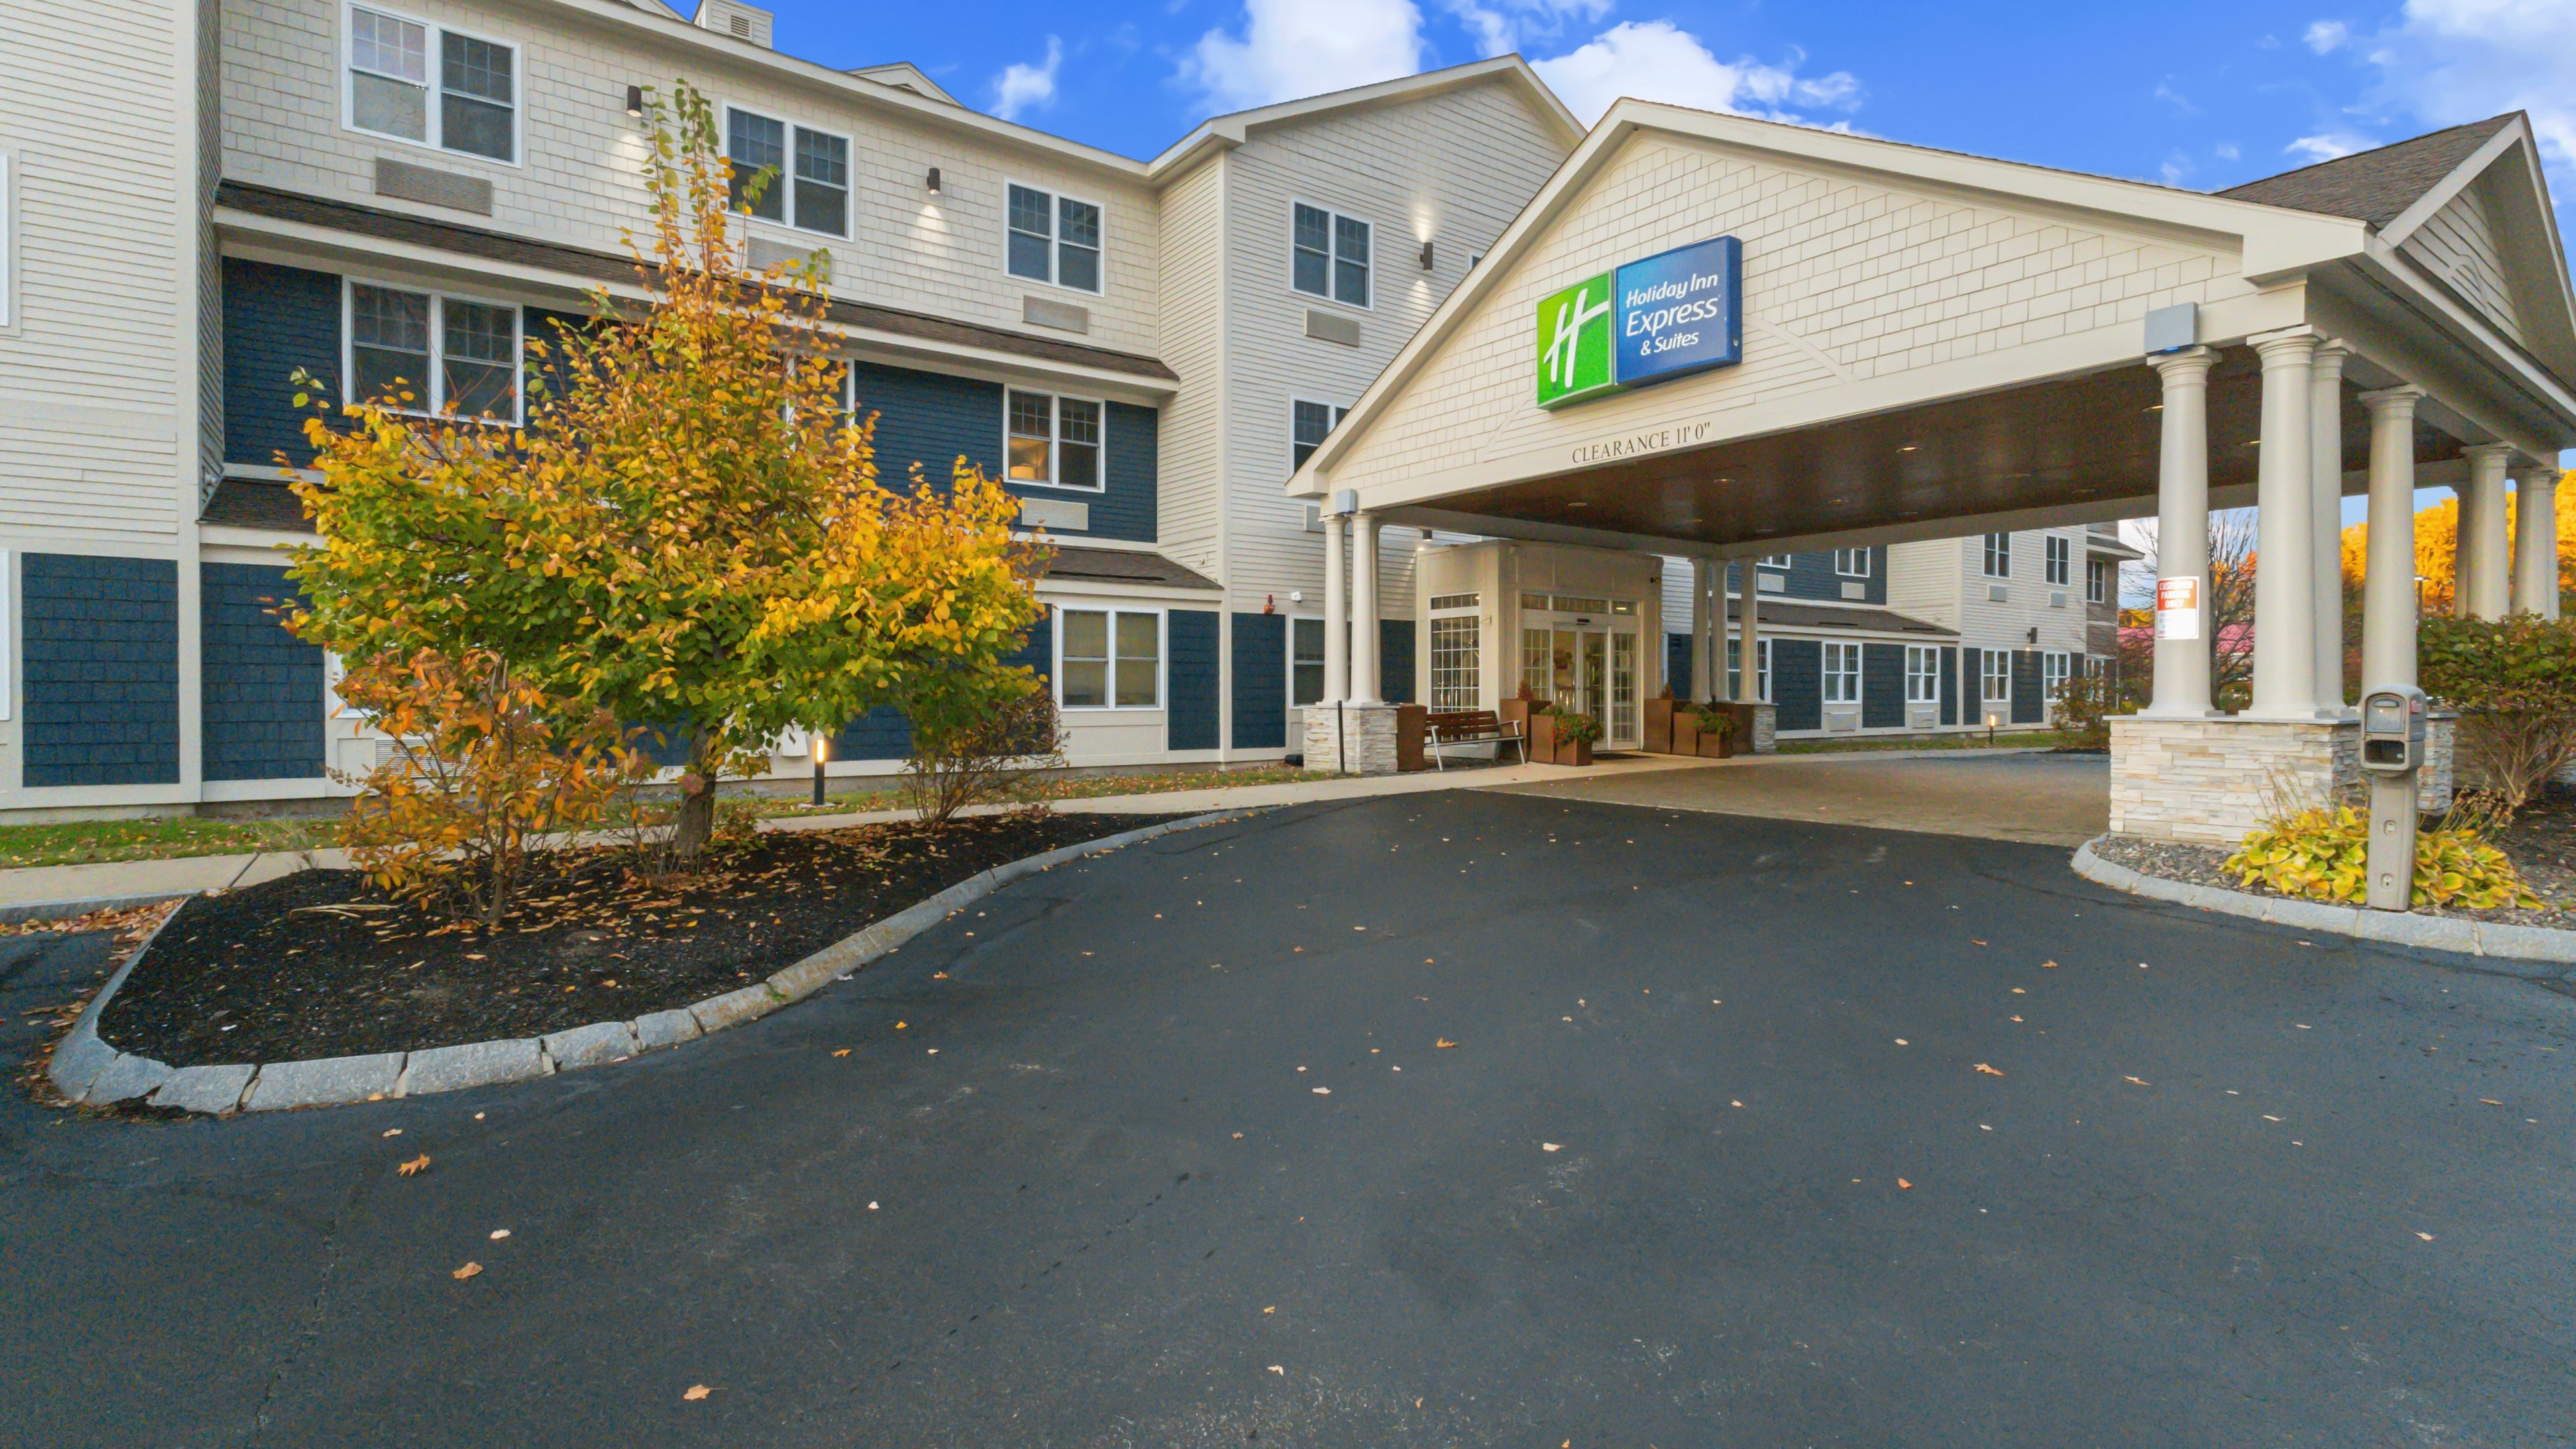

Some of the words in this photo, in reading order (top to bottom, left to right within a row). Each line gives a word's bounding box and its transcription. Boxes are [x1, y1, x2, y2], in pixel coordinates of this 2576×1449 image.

[1626, 281, 1688, 308] Holiday
[1690, 273, 1718, 292] Inn
[1626, 298, 1719, 337] Express
[1640, 340, 1651, 356] &
[1654, 332, 1699, 353] Suites
[1572, 431, 1670, 464] CLEARANCE
